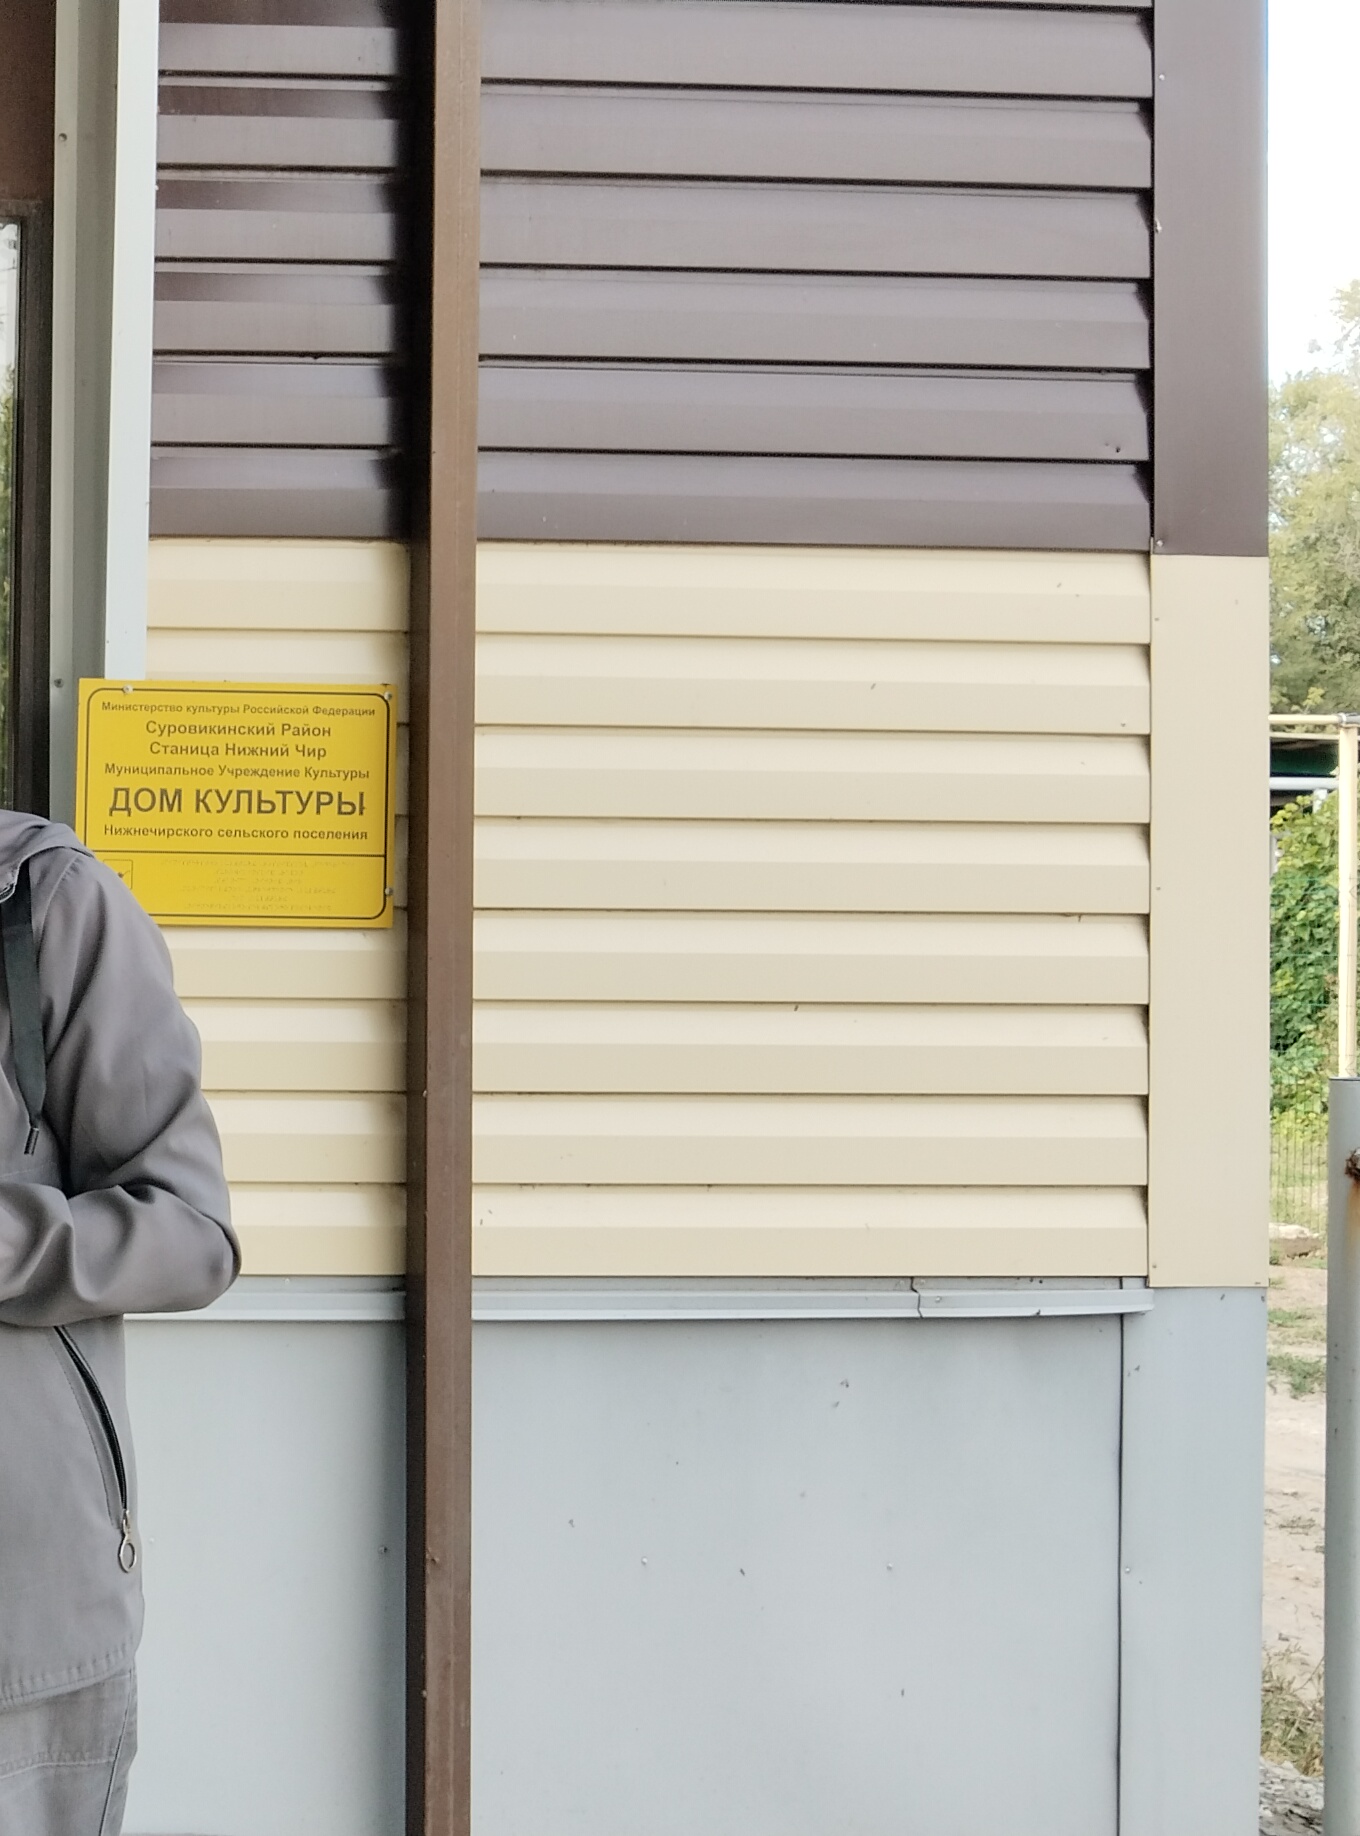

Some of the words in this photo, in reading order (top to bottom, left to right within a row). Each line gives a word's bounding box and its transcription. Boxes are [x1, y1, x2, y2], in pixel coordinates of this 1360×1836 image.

[102, 701, 183, 712] Министерство
[186, 705, 240, 716] культуры
[243, 704, 309, 715] Российской
[312, 706, 376, 717] Федерации
[145, 720, 275, 738] Суровикинский
[281, 723, 331, 737] Район
[149, 741, 219, 758] Станица
[225, 743, 289, 757] Нижний
[295, 744, 327, 761] Чир
[104, 762, 214, 777] Муниципальное
[218, 764, 301, 779] Учреждение
[304, 767, 370, 781] Культуры
[108, 787, 183, 817] ДОМ
[195, 788, 366, 816] КУЛЬТУРЫ
[104, 824, 213, 839] Нижнечирского
[217, 829, 289, 839] сельского
[293, 830, 368, 840] поселения
